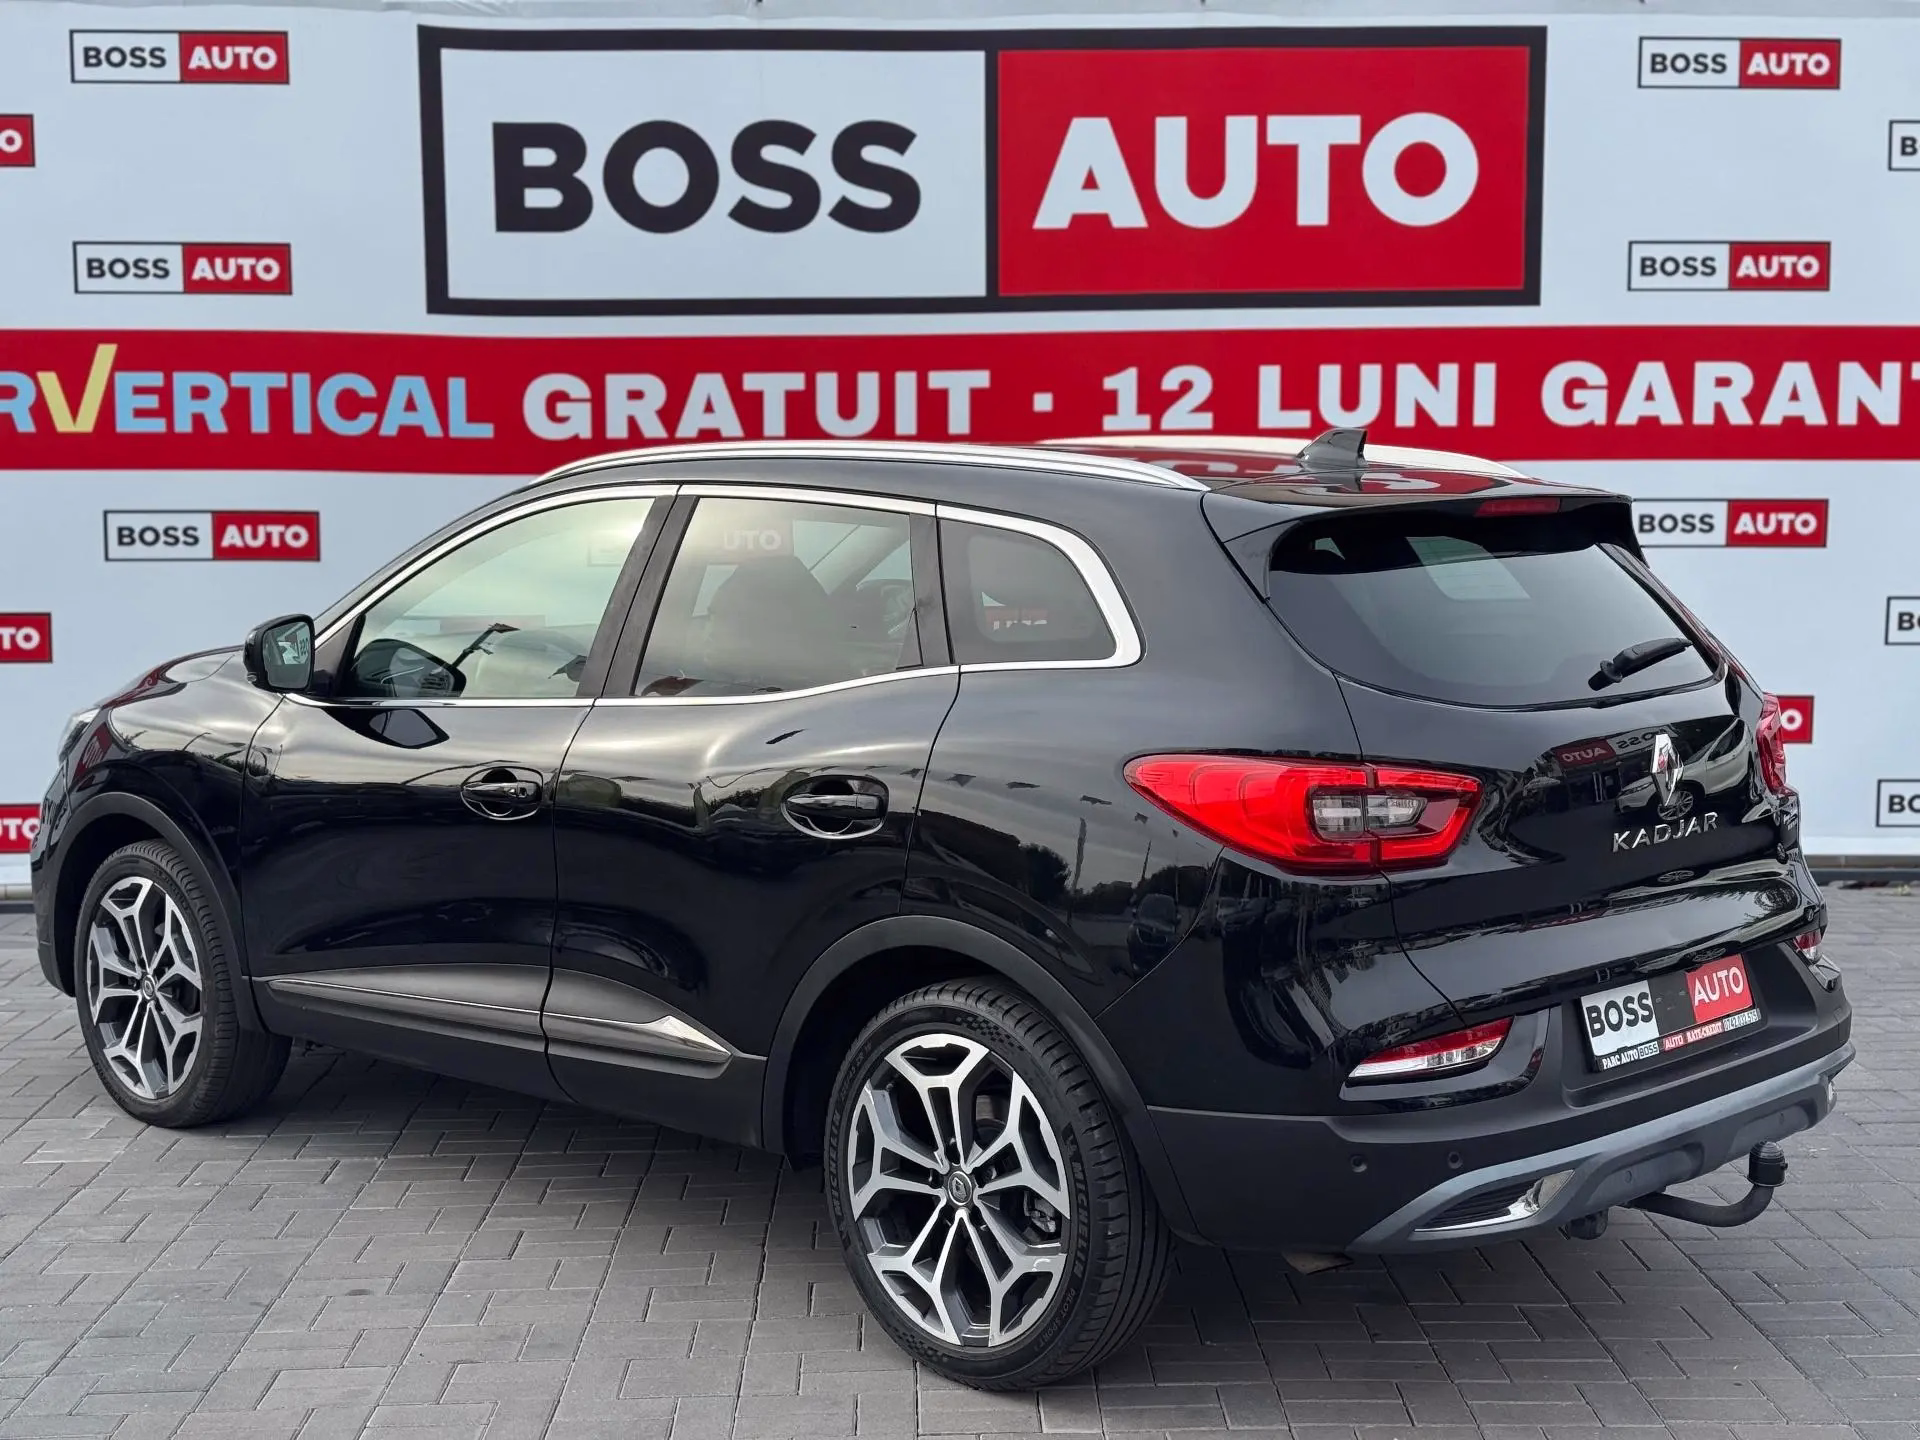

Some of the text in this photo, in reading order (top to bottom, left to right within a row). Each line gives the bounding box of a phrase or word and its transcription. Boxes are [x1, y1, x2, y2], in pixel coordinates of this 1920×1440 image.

[83, 46, 277, 70] BOSS AUTO
[1650, 53, 1830, 76] BOSS AUTO
[1901, 136, 1920, 156] B
[493, 112, 1479, 233] BOSS AUTO
[86, 257, 280, 281] BOSS AUTO
[1640, 256, 1820, 278] BOSS AUTO
[523, 369, 990, 440] GRATUIT
[1102, 365, 1213, 431] 12
[1258, 362, 1496, 429] LUNI
[1541, 360, 1920, 427] GARAN
[1638, 513, 1817, 535] BOSS AUTO
[117, 525, 309, 548] BOSS AUTO
[1898, 611, 1920, 631] B
[0, 817, 41, 841] TO
[1612, 811, 1718, 853] KADJAR
[1585, 966, 1744, 1038] BOSS AUTO
[1620, 1048, 1639, 1065] AUTO
[1639, 1042, 1659, 1058] BOSS
[1664, 1034, 1684, 1051] AUTO
[1071, 1160, 1090, 1279] MICHELIN
